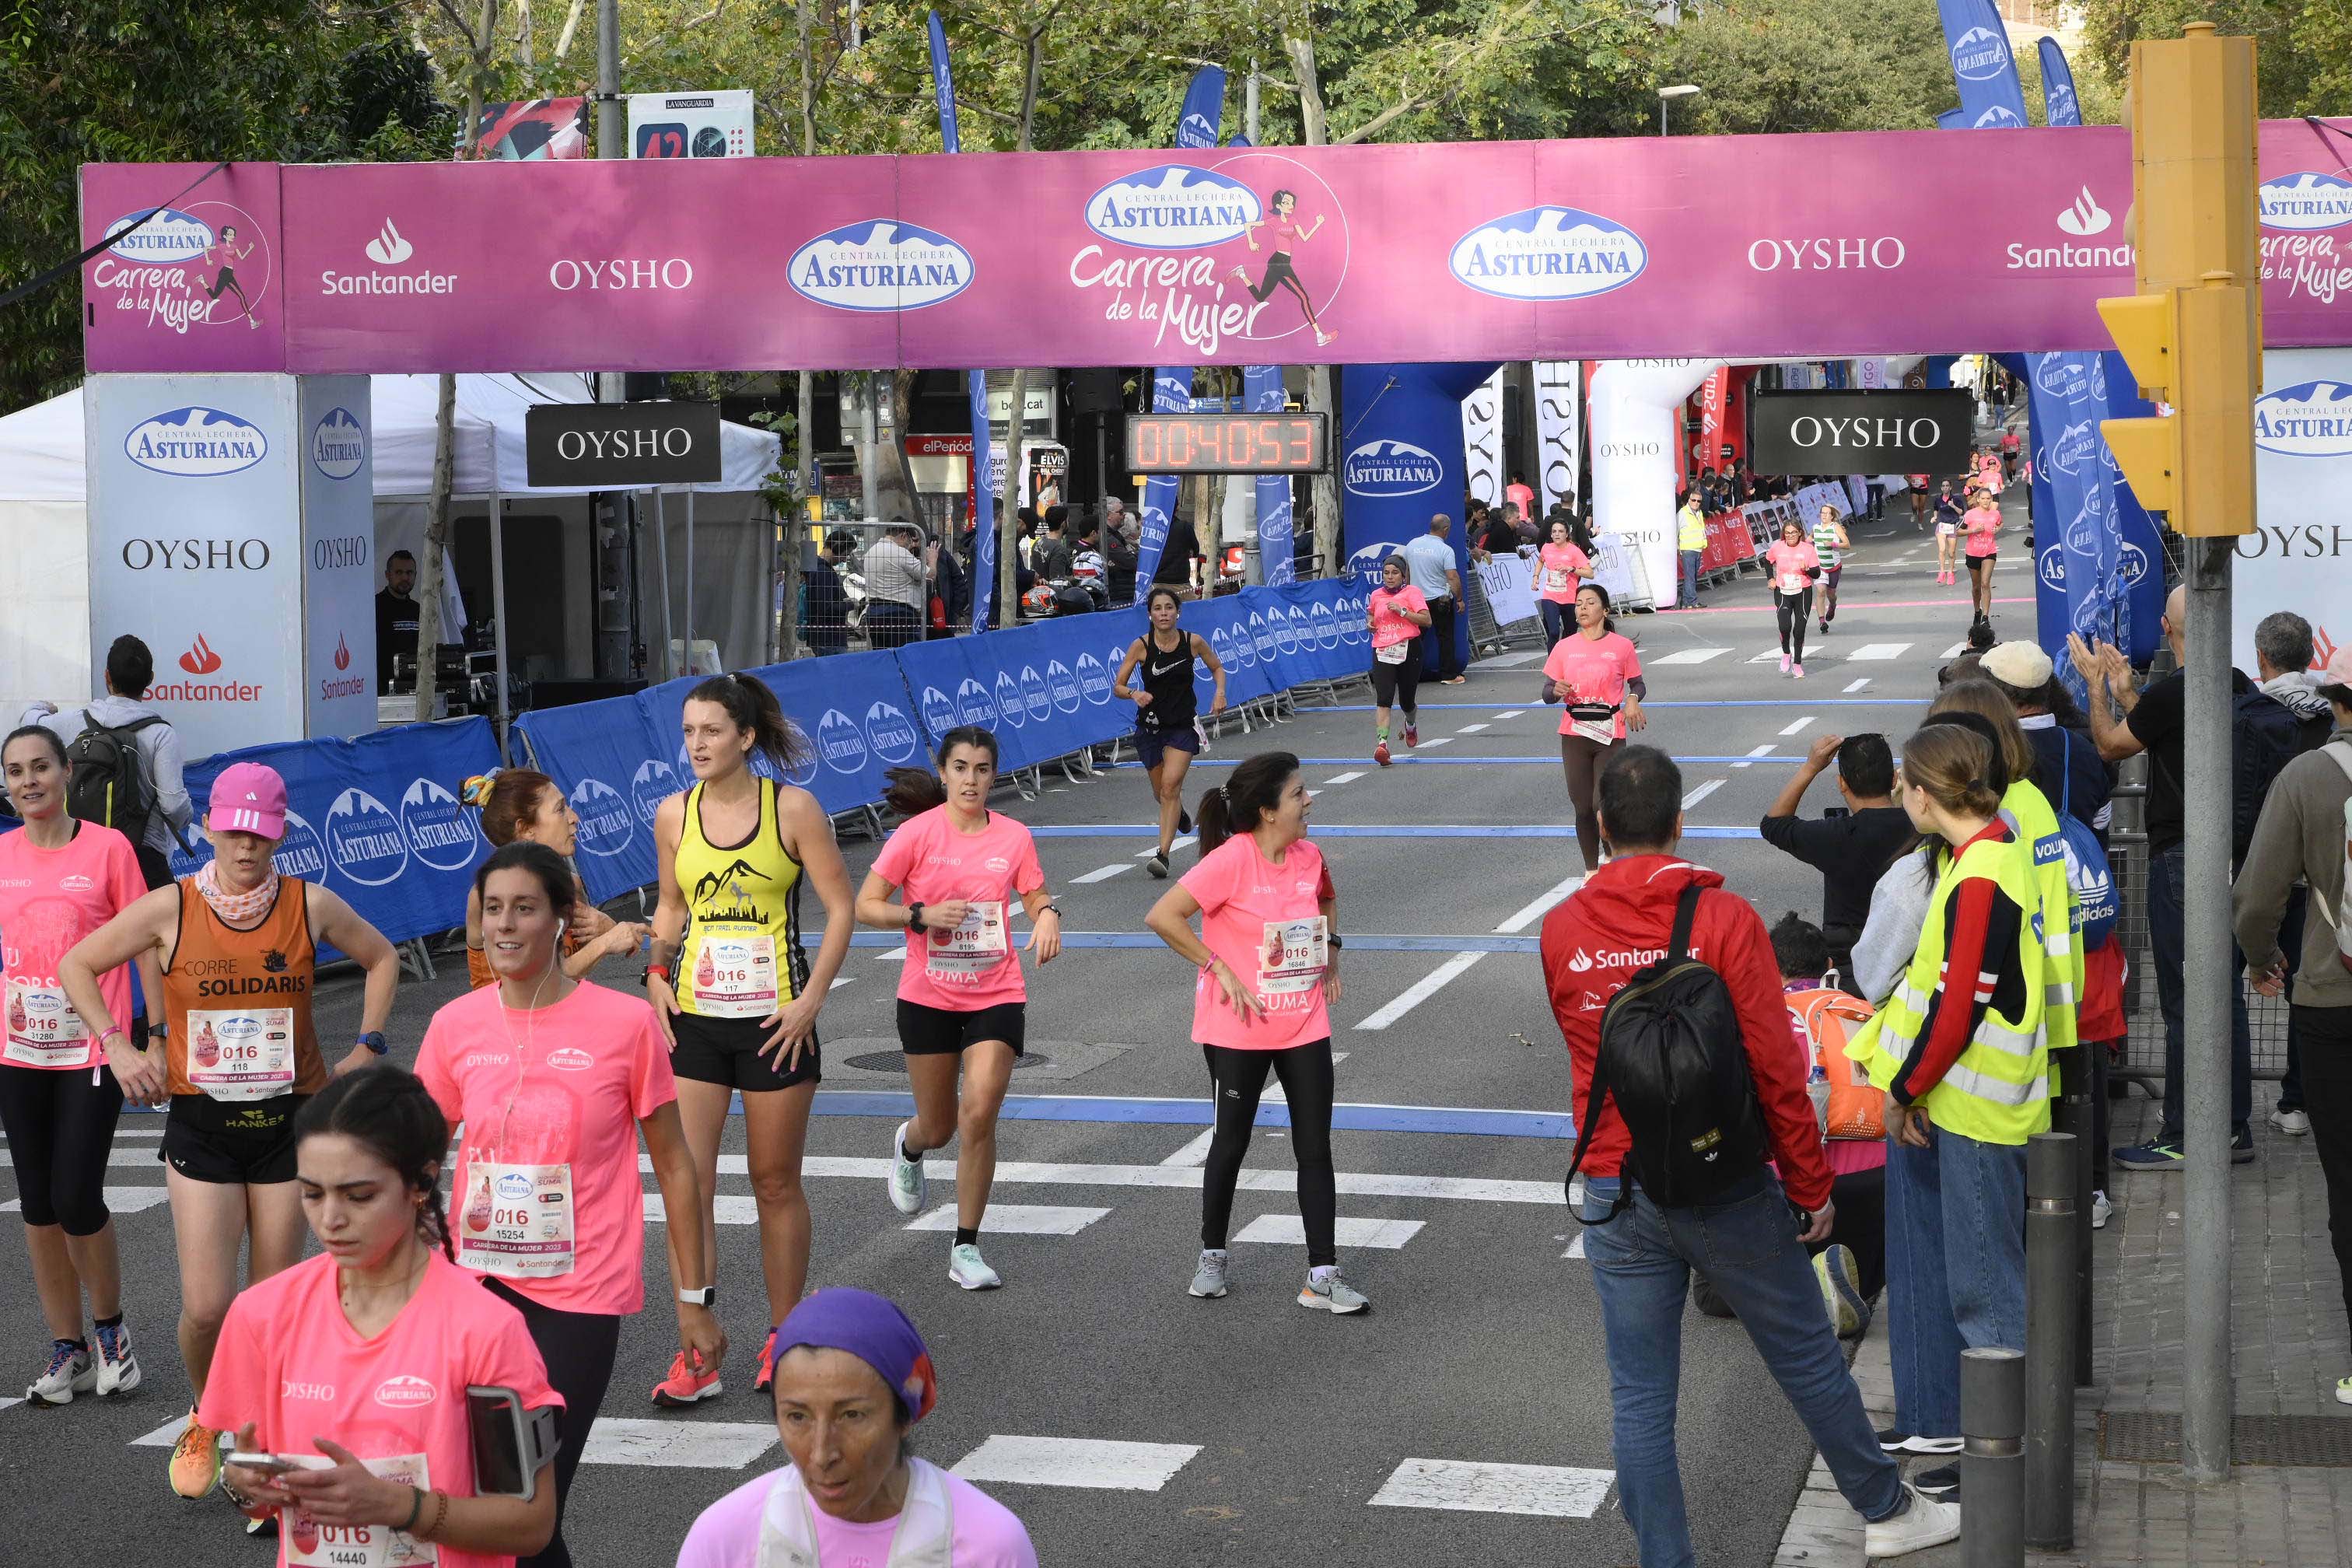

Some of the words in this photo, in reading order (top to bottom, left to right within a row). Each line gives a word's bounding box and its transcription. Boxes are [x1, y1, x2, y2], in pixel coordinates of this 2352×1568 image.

[1125, 193, 1181, 203] CENTRAL
[1186, 192, 1244, 202] LECHERA
[2259, 194, 2352, 216] ASTURIAN
[1098, 196, 1249, 229] ASTURIANA
[1494, 238, 1557, 249] CENTRAL
[1563, 236, 1626, 247] LECHERA
[2259, 235, 2334, 257] arrera
[830, 251, 889, 261] CENTRAL
[1465, 242, 1633, 277] ASTURIANA
[1748, 236, 1906, 271] OYSHO
[2006, 243, 2137, 269] Santand
[93, 260, 184, 289] Carrera
[550, 257, 693, 291] OYSHO
[801, 254, 961, 288] ASTURIANA
[1069, 244, 1216, 289] Carrera
[2277, 258, 2292, 279] la
[321, 270, 458, 296] Santander
[2288, 253, 2352, 304] Muje
[117, 289, 135, 310] de
[137, 287, 150, 310] la
[1105, 290, 1132, 320] de
[1138, 289, 1158, 320] la
[147, 285, 221, 334] Mujer
[1153, 282, 1270, 356] Mujer
[1001, 399, 1043, 411] b.cat
[2276, 407, 2329, 415] CENTRAL
[1790, 416, 1941, 449] OYSHO
[2255, 410, 2352, 438] ASTURIA
[135, 432, 257, 460] ASTURIANA
[316, 436, 362, 464] ASTURIANA
[557, 427, 692, 460] OYSHO
[922, 439, 975, 453] elPeriód
[1138, 421, 1312, 466] 00:40:53
[1600, 442, 1659, 458] OYSHO
[1040, 454, 1065, 465] ELVIS
[1347, 464, 1436, 485] ASTURIANA
[2233, 525, 2352, 558] OYSH
[122, 538, 270, 570] OYSHO
[315, 535, 366, 571] OYSHO
[141, 680, 263, 702] Santander
[320, 675, 366, 701] Santander
[822, 733, 865, 761] ASTURIANA
[341, 821, 368, 834] CENTRAL
[368, 817, 393, 829] LECHERA
[407, 815, 474, 851] ASTURIANA
[332, 827, 404, 866] ASTURIANA
[2035, 838, 2062, 859] VOLU
[171, 856, 197, 869] ENTRAL
[270, 845, 324, 877] URIANA
[928, 856, 962, 866] OYSHO
[955, 930, 978, 940] 016
[1286, 947, 1308, 959] 016
[1595, 947, 1700, 969] Santanr
[184, 958, 237, 977] CORRE
[717, 969, 746, 982] 016
[198, 975, 306, 998] SOLIDARIS
[27, 999, 59, 1009] ASTURIANA
[1255, 991, 1308, 1011] SUMA
[29, 1017, 58, 1030] 016
[220, 1025, 258, 1034] ASTURIANA
[31, 1032, 54, 1041] 31280
[12, 1047, 34, 1058] OYSHO
[222, 1045, 258, 1059] 016
[467, 1053, 509, 1067] OYSHO
[550, 1055, 591, 1066] ASTURIANA
[231, 1062, 248, 1072] 118
[499, 1182, 530, 1194] ASTURIANA
[495, 1209, 529, 1225] 016
[496, 1230, 524, 1240] 15254
[469, 1256, 502, 1267] OYSHO
[526, 1259, 565, 1269] Santander
[380, 1388, 432, 1401] ASTURIANA
[322, 1524, 371, 1544] 016
[329, 1551, 366, 1565] 14440
